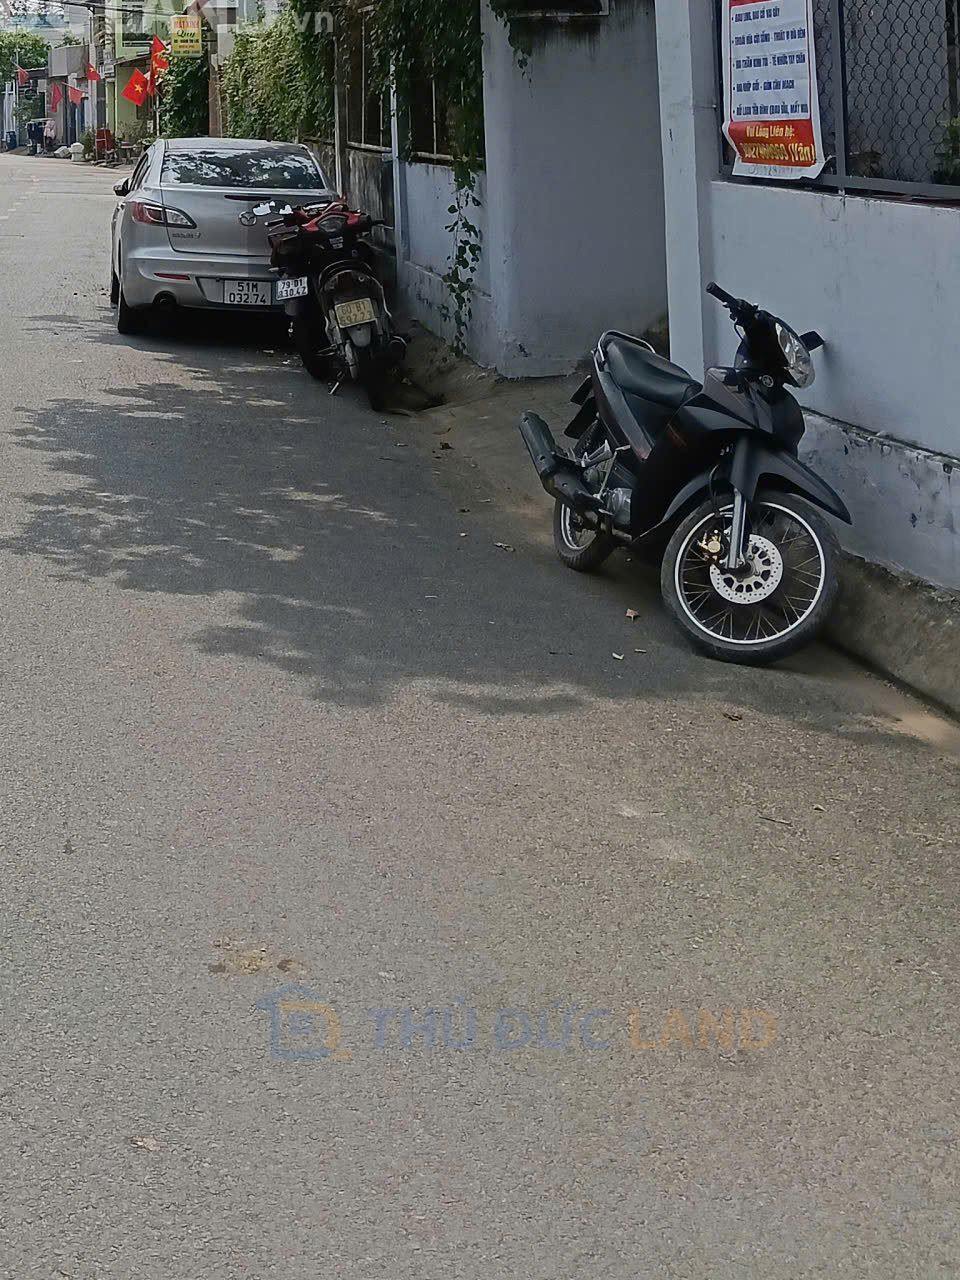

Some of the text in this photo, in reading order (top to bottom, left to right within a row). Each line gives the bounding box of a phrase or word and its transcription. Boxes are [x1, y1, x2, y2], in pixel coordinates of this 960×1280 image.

[789, 143, 815, 163] (Vân)
[238, 282, 258, 292] 51M
[229, 293, 266, 304] 032.74
